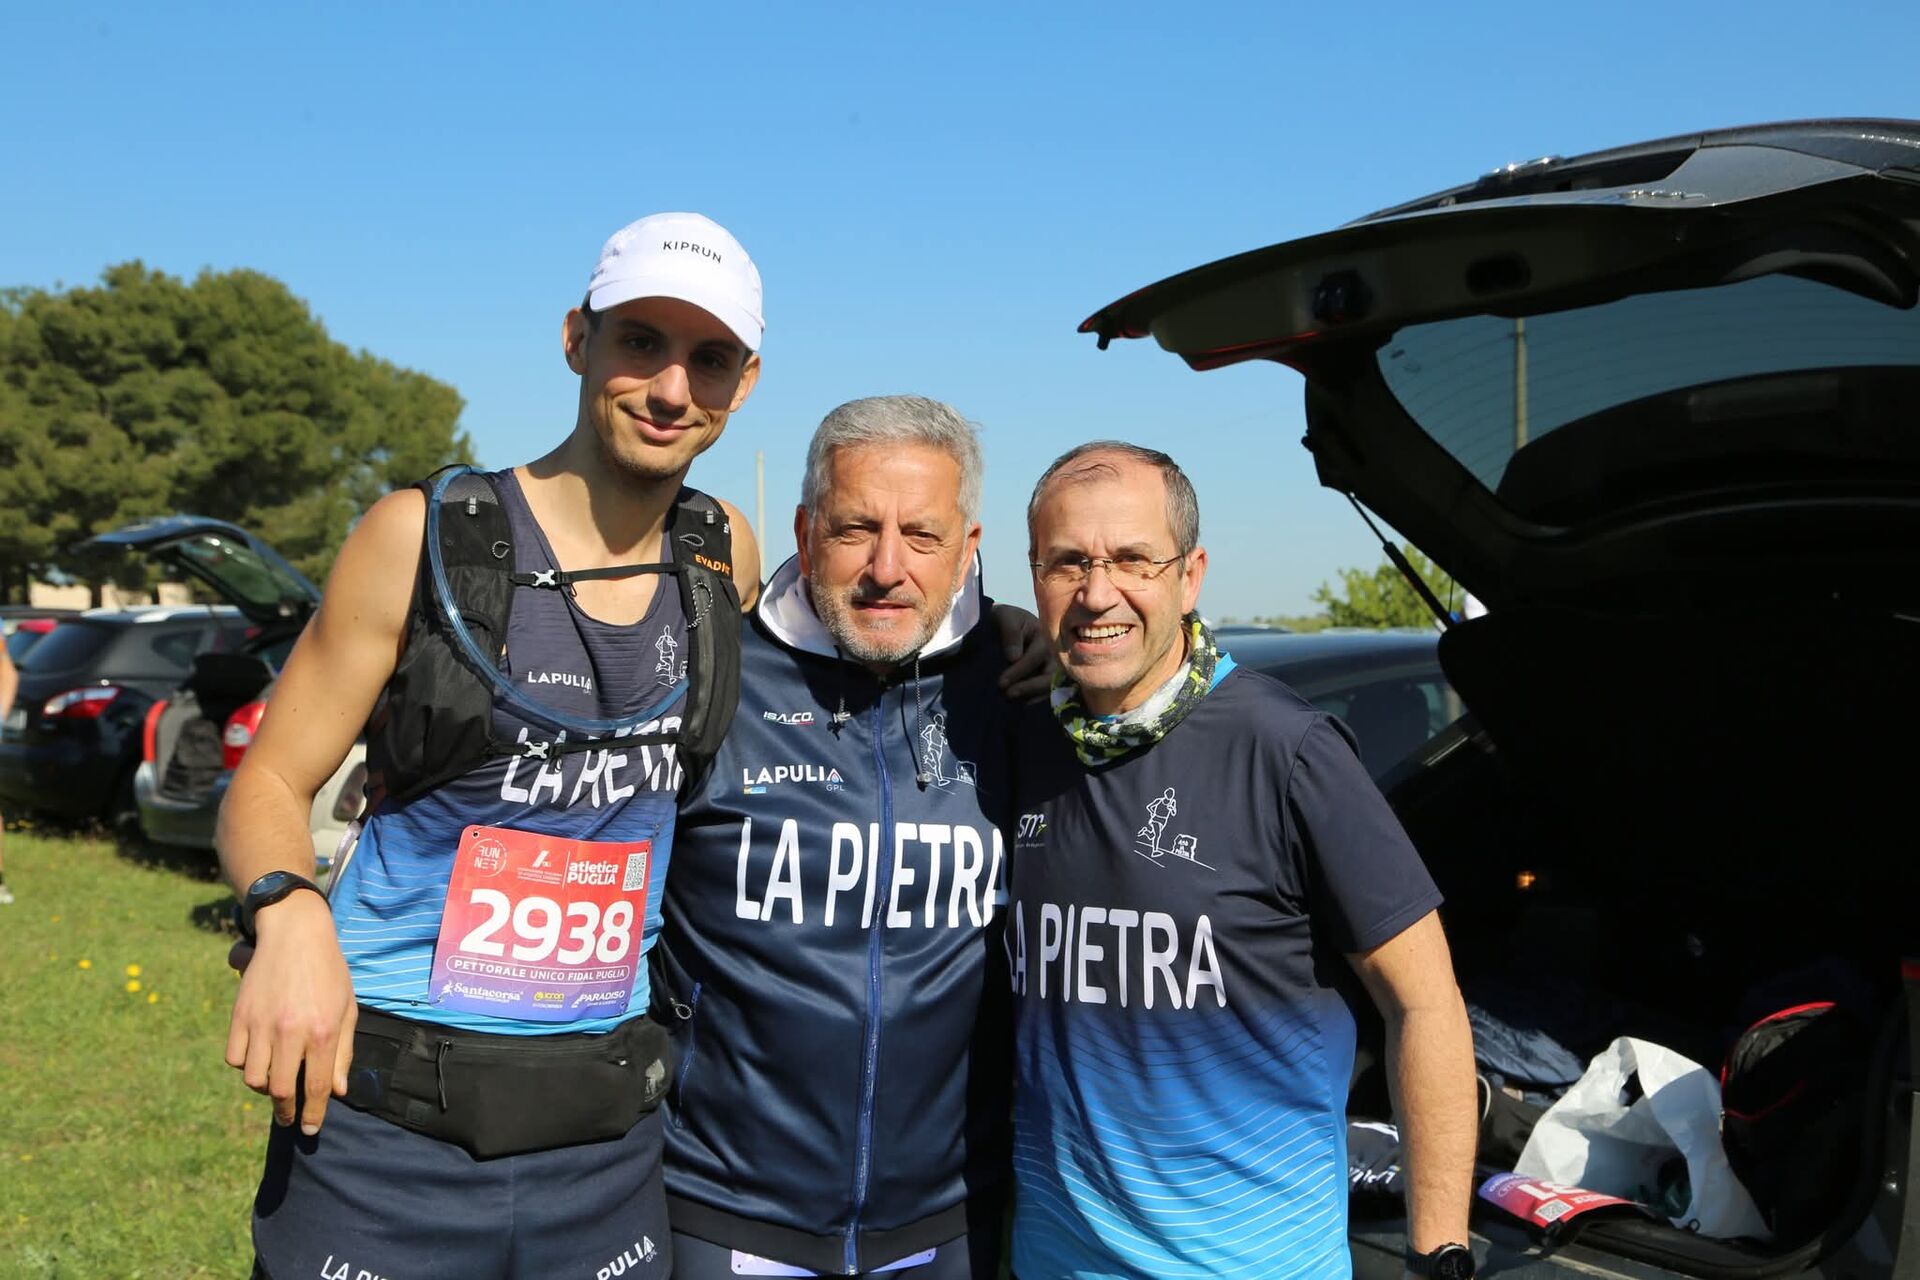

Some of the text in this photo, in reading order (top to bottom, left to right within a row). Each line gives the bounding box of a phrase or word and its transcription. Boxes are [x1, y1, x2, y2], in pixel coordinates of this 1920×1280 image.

[663, 240, 722, 263] KIPRUN
[527, 671, 592, 690] LAPULIA
[743, 764, 844, 785] LAPULIA
[569, 860, 619, 873] atletica
[735, 816, 1006, 929] LA PIETRA
[567, 872, 616, 885] PUGLIA
[458, 888, 634, 965] 2938
[1040, 903, 1227, 1010] PIETRA
[454, 959, 625, 981] PETTORALE UNICO FIDAL PUGLIA
[454, 982, 521, 1000] Santacorsa
[580, 990, 625, 1002] PARADISO
[320, 1255, 350, 1280] LA
